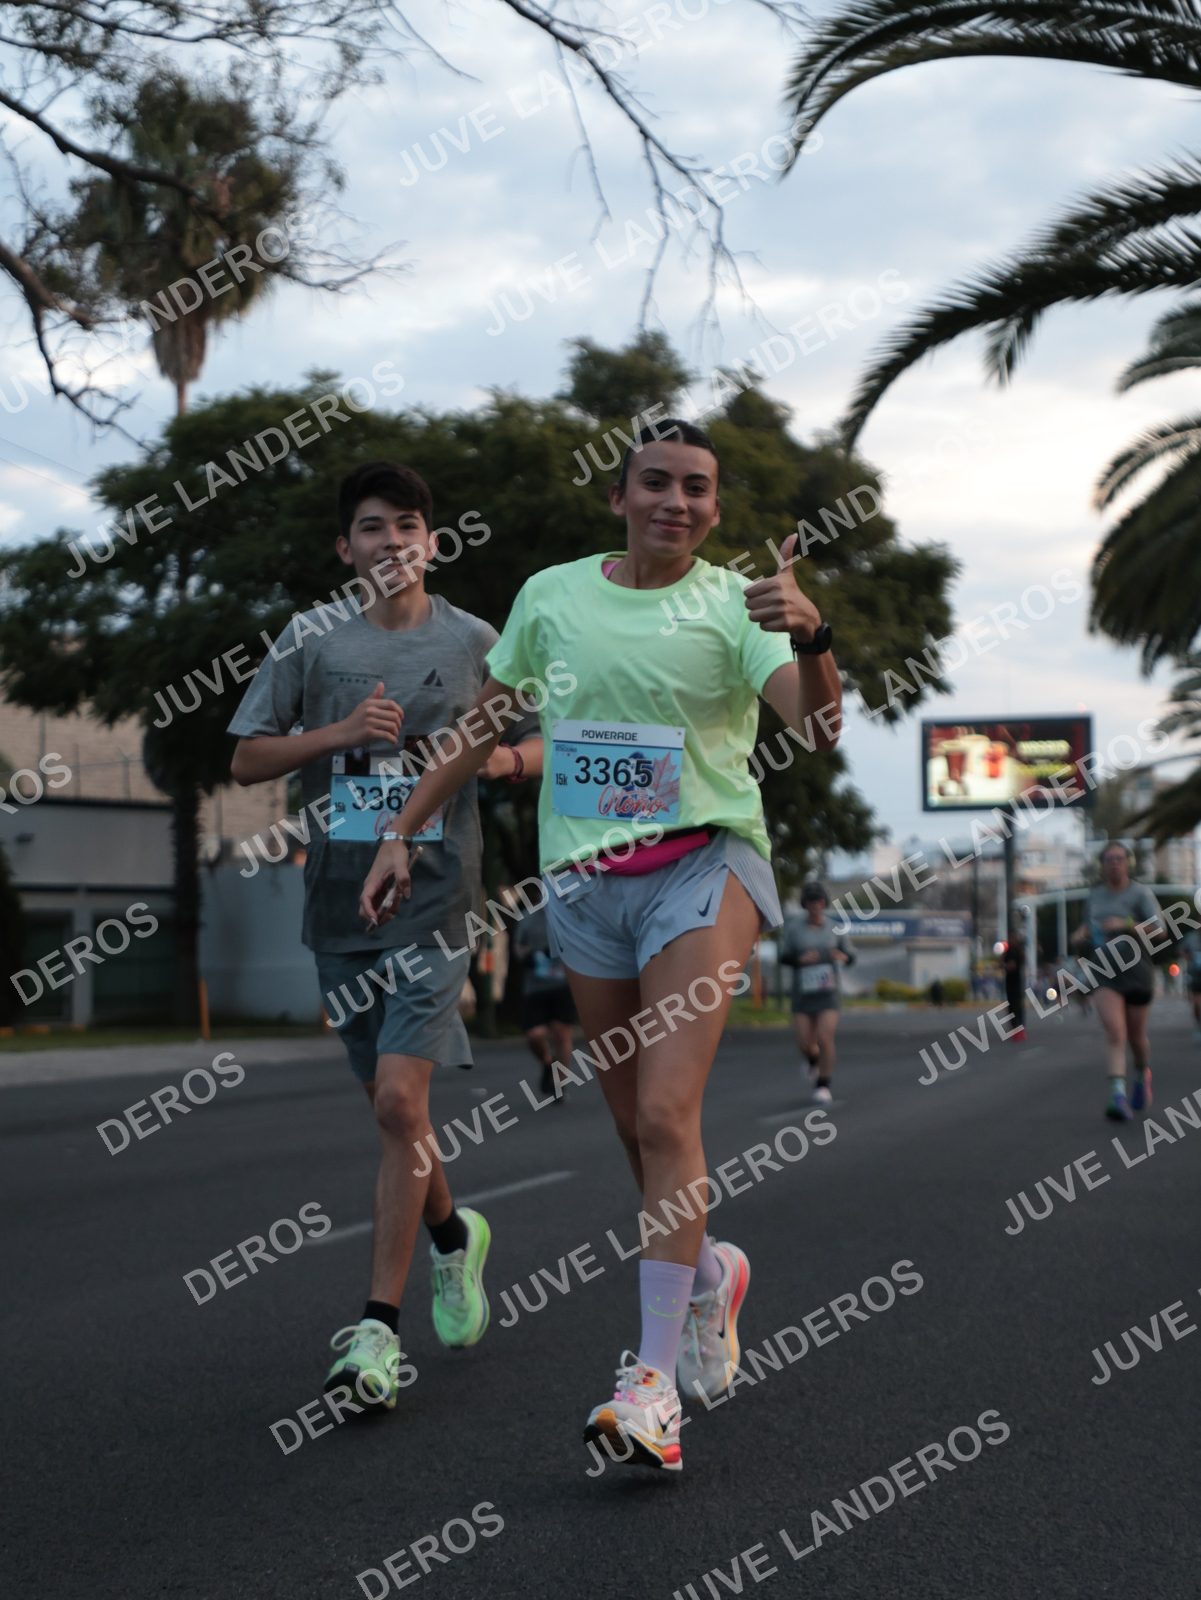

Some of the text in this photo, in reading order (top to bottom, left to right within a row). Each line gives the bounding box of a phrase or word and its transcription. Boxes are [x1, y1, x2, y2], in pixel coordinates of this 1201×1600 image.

[581, 729, 638, 741] POWERADE
[574, 755, 653, 788] 3365
[352, 786, 412, 811] 336
